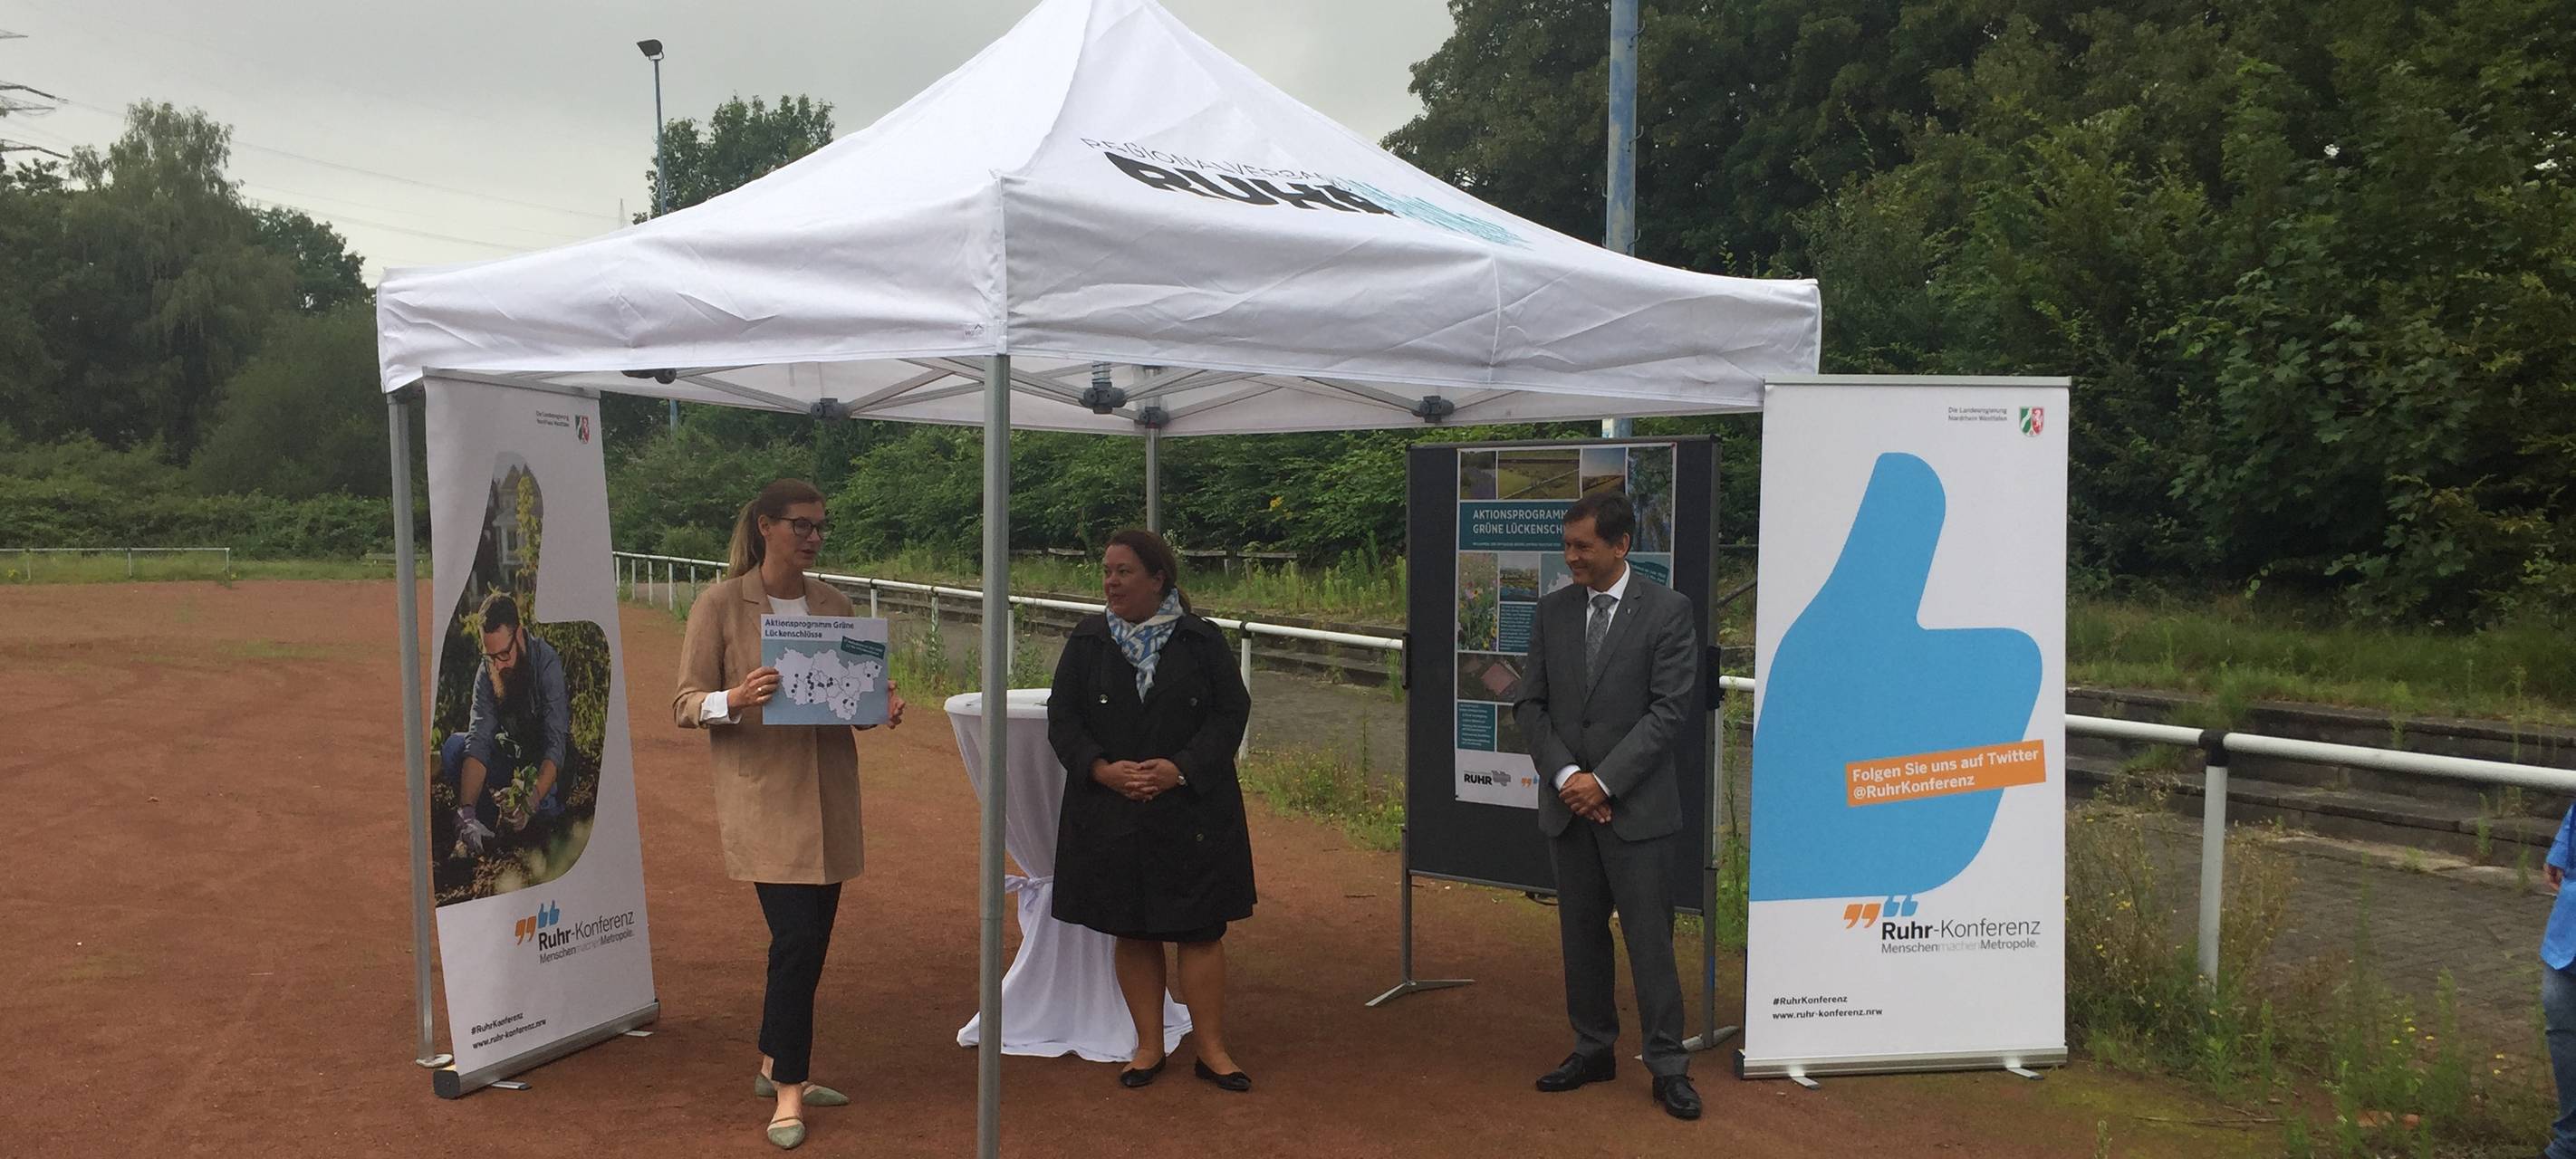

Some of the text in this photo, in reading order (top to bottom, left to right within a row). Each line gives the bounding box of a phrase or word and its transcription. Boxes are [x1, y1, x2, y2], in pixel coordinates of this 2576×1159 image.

[1104, 151, 1401, 218] RUHR
[1473, 522, 1565, 534] GRÜNE LÜCKENSCH
[764, 618, 854, 629] Aktionsprogramm Grüne
[764, 630, 822, 638] Lückenschlüsse
[1852, 748, 2039, 782] Folgen Sie uns auf Twitter
[1464, 773, 1493, 786] RUHR
[1853, 774, 1975, 800] @RuhrKonferenz
[538, 911, 635, 951] Ruhr-Konferenz
[1881, 918, 2041, 940] Ruhr-Konferenz
[1773, 995, 1848, 1006] #RuhrKonferenz
[471, 1012, 524, 1035] #RuhrKonferenz
[1773, 1008, 1883, 1020] www.ruhr-konferenz.nrw
[473, 1019, 546, 1049] www.ruhr-konferenz.nrw
